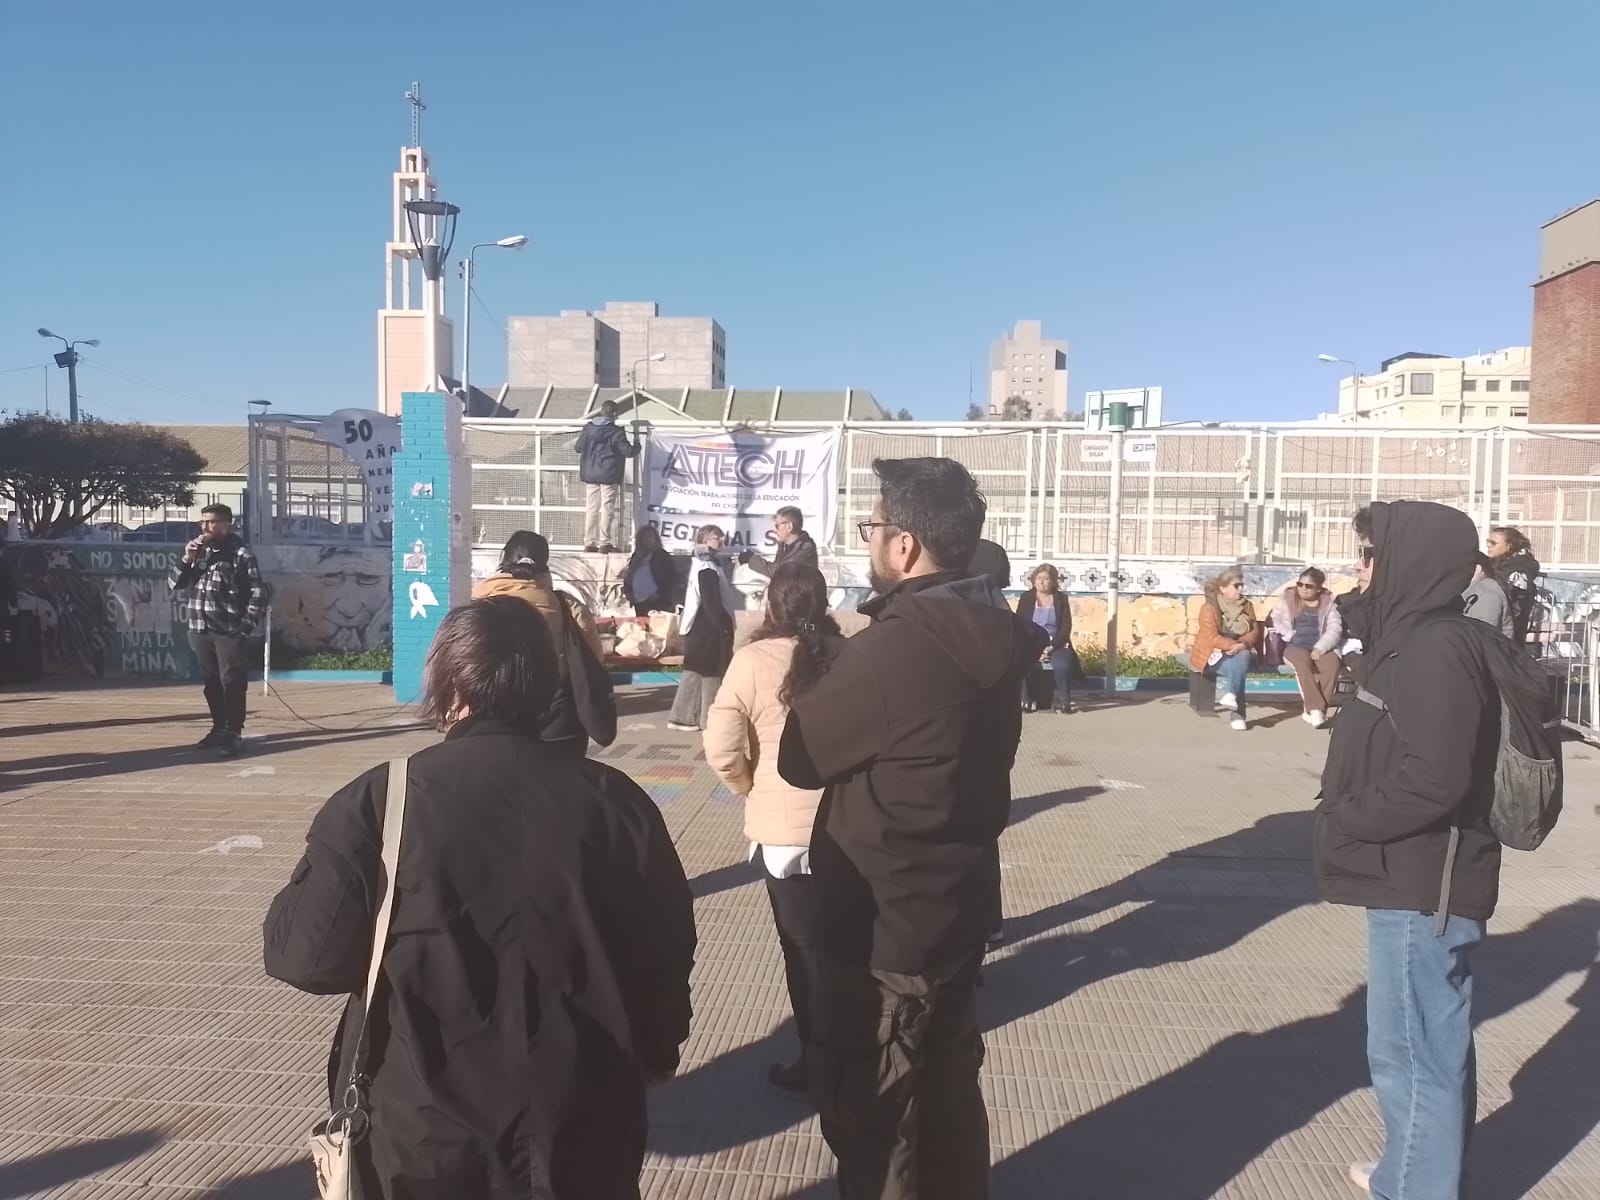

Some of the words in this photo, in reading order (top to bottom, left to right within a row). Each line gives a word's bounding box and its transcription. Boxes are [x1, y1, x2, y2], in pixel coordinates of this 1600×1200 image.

[343, 419, 373, 444] 50
[662, 444, 806, 489] ATECH
[762, 493, 800, 502] EDUCACIÓN
[647, 519, 758, 547] REGIAL
[90, 551, 112, 568] NO
[123, 551, 178, 570] SOMOS
[142, 633, 153, 648] A
[157, 632, 175, 648] LA
